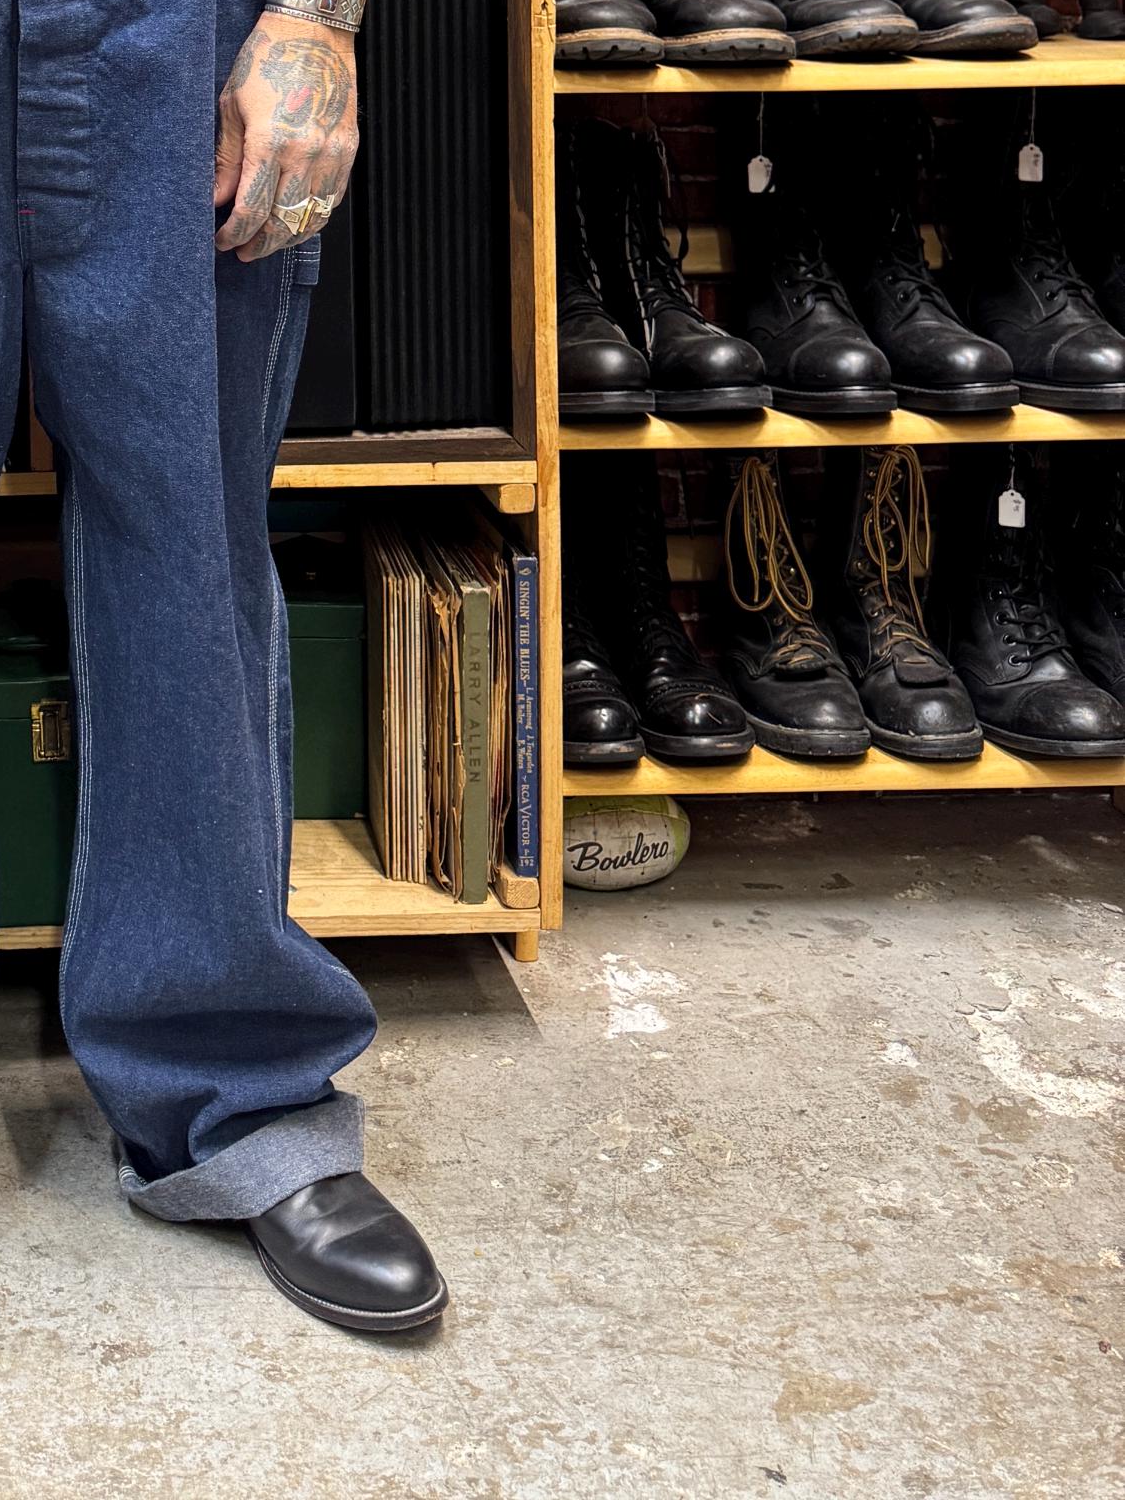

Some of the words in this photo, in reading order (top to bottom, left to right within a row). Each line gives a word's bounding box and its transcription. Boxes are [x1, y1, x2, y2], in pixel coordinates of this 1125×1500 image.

[519, 580, 531, 620] SINGIN'
[519, 623, 530, 644] THE
[469, 632, 481, 706] LARRY
[525, 696, 535, 730] Armstrong
[469, 719, 481, 783] ALLEN
[525, 741, 535, 773] Teagarden
[521, 784, 529, 804] RCA
[566, 832, 669, 872] Bowlero
